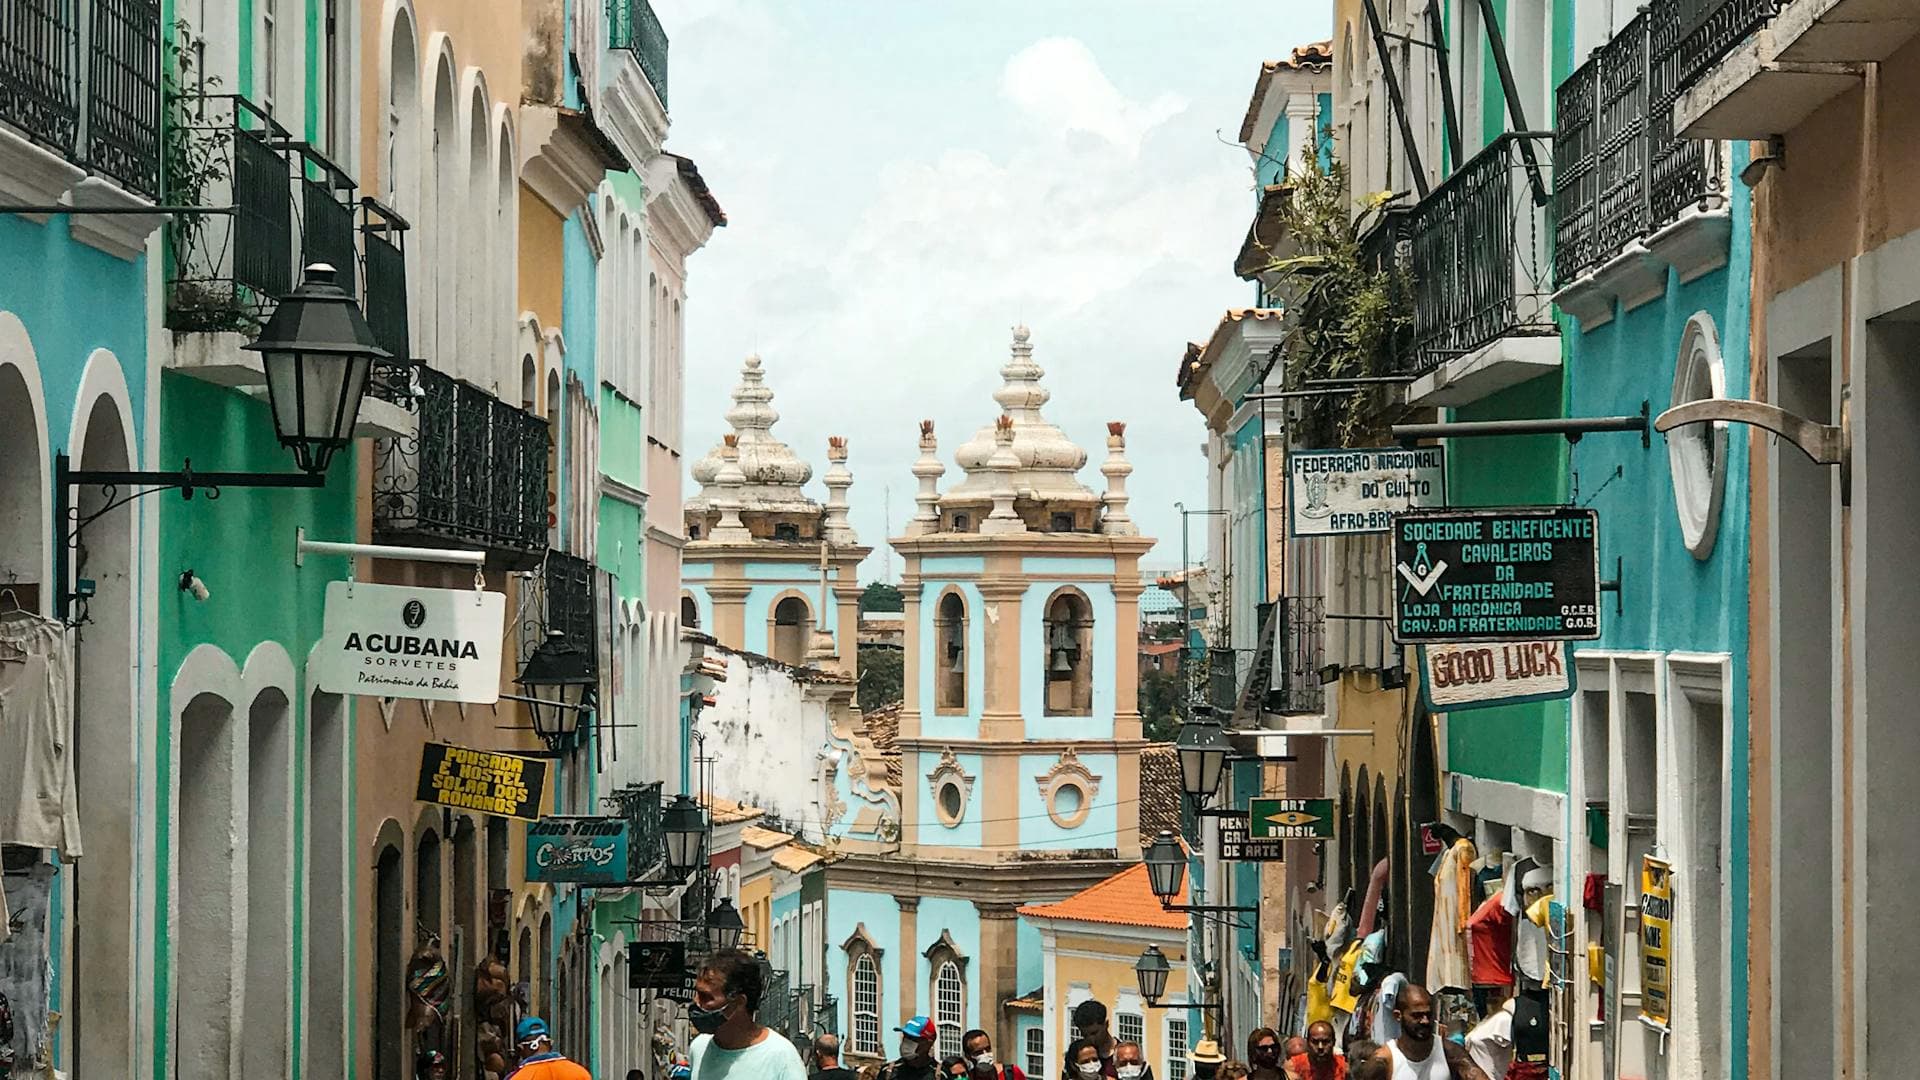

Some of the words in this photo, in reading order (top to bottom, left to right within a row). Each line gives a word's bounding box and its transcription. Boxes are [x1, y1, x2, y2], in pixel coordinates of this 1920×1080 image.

[1294, 454, 1370, 474] FEDERAÇÃO
[1377, 452, 1440, 470] NACIONAL
[1362, 482, 1379, 499] DO
[1385, 480, 1431, 498] CULTO
[1330, 510, 1393, 530] AFRO-BRA
[1404, 521, 1483, 542] SOCIEDADE
[1492, 518, 1593, 541] BENEFICENTE
[1461, 542, 1553, 563] CAVALEIROS
[1417, 564, 1427, 576] G
[1495, 565, 1515, 582] DA
[1443, 582, 1554, 601] FRATERNIDADE
[1404, 603, 1441, 618] LOJA
[1452, 599, 1522, 619] MAÇÔNICA
[1459, 616, 1563, 632] FRATERNIDADE
[364, 656, 457, 671] SORVETES
[1431, 648, 1495, 688] GOOD
[1502, 641, 1562, 680] LUCK
[358, 671, 414, 687] Patrimônio
[416, 677, 429, 688] da
[431, 677, 460, 690] Bahia
[439, 760, 452, 776] E
[445, 747, 524, 773] POUSADA
[432, 774, 488, 796] SOLAR
[494, 784, 528, 803] DOS
[438, 789, 518, 815] ROMANOS
[1280, 800, 1306, 811] ART
[1268, 826, 1317, 838] BRASIL
[1223, 845, 1240, 857] DE
[1245, 845, 1279, 857] ARTE
